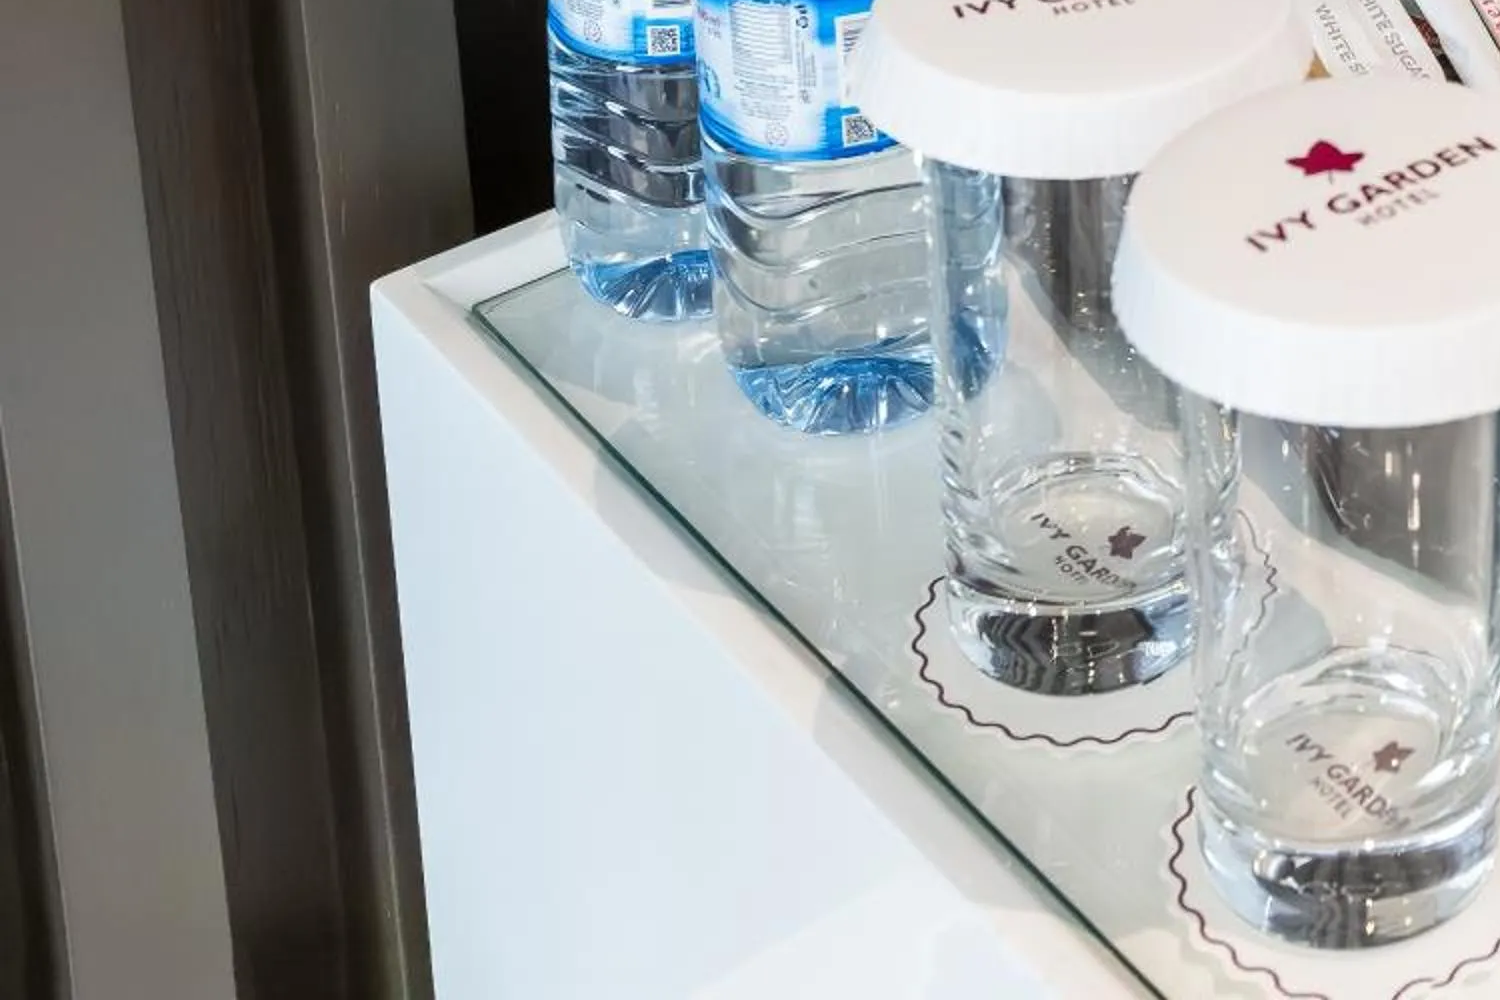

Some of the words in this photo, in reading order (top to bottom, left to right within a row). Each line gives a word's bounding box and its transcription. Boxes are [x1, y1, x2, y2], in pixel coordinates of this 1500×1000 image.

[1315, 4, 1358, 64] WHITE
[1244, 210, 1317, 252] IVY
[1327, 135, 1497, 215] GARDEN
[1355, 188, 1440, 226] HOTEL
[1030, 512, 1072, 540] IVY
[1285, 733, 1335, 763] IVY
